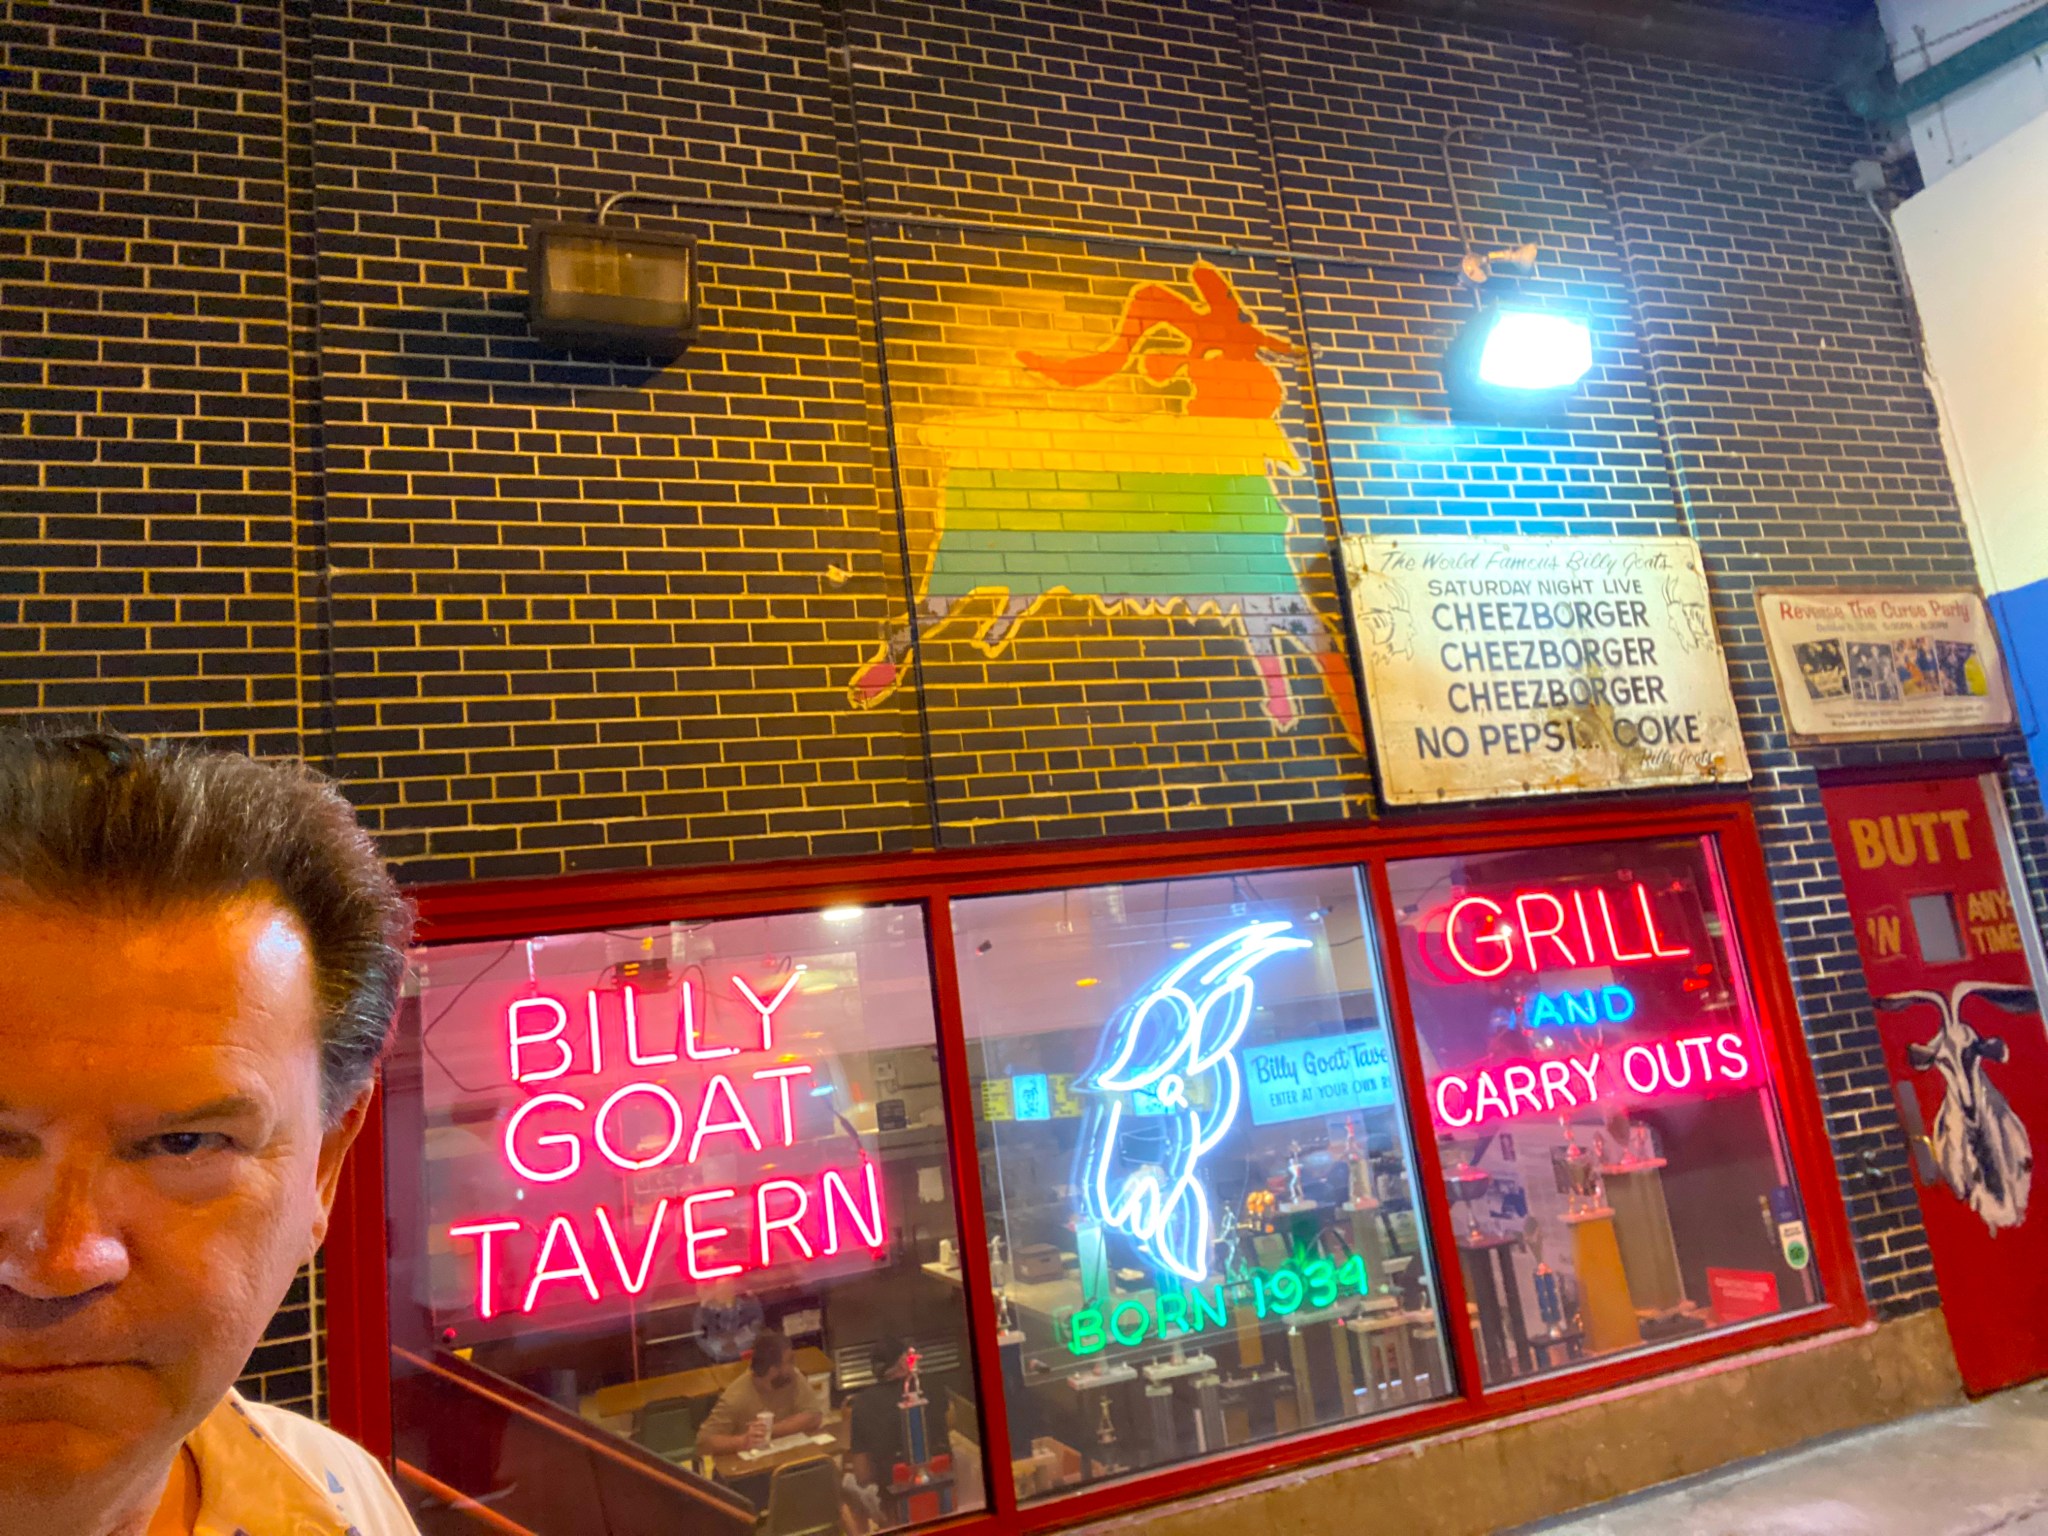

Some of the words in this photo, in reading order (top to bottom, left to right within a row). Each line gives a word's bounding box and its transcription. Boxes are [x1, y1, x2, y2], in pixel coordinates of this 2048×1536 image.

[1380, 550, 1417, 572] The
[1422, 551, 1480, 571] World
[1484, 551, 1560, 570] Famous
[1566, 550, 1618, 576] Billy
[1622, 551, 1673, 577] Goats
[1428, 578, 1532, 597] SATURDAY
[1537, 578, 1594, 596] NIGHT
[1602, 578, 1644, 595] LIVE
[1432, 600, 1650, 633] CHEEZBORGER
[1846, 600, 1877, 620] The
[1880, 600, 1928, 620] Curse
[1928, 599, 1970, 623] Party
[1439, 637, 1658, 672] CHEEZBORGER
[1447, 675, 1668, 714] CHEEZBORGER
[1415, 725, 1469, 760] NO
[1613, 714, 1701, 749] COKE
[1848, 809, 1972, 870] BUTT
[1446, 883, 1691, 977] GRILL
[507, 963, 809, 1084] BILLY
[1531, 985, 1637, 1028] AND
[1251, 1054, 1300, 1085] Billy
[1302, 1047, 1350, 1077] Goat
[1435, 1052, 1601, 1128] CARRY
[1622, 1032, 1750, 1094] OUTS
[1269, 1089, 1298, 1107] ENTER
[1301, 1087, 1313, 1102] AT
[1315, 1081, 1349, 1100] YOUR
[504, 1064, 812, 1182] GOAT
[448, 1160, 884, 1319] TAVERN
[1067, 1284, 1229, 1356] BORN
[1253, 1253, 1369, 1319] 1934
